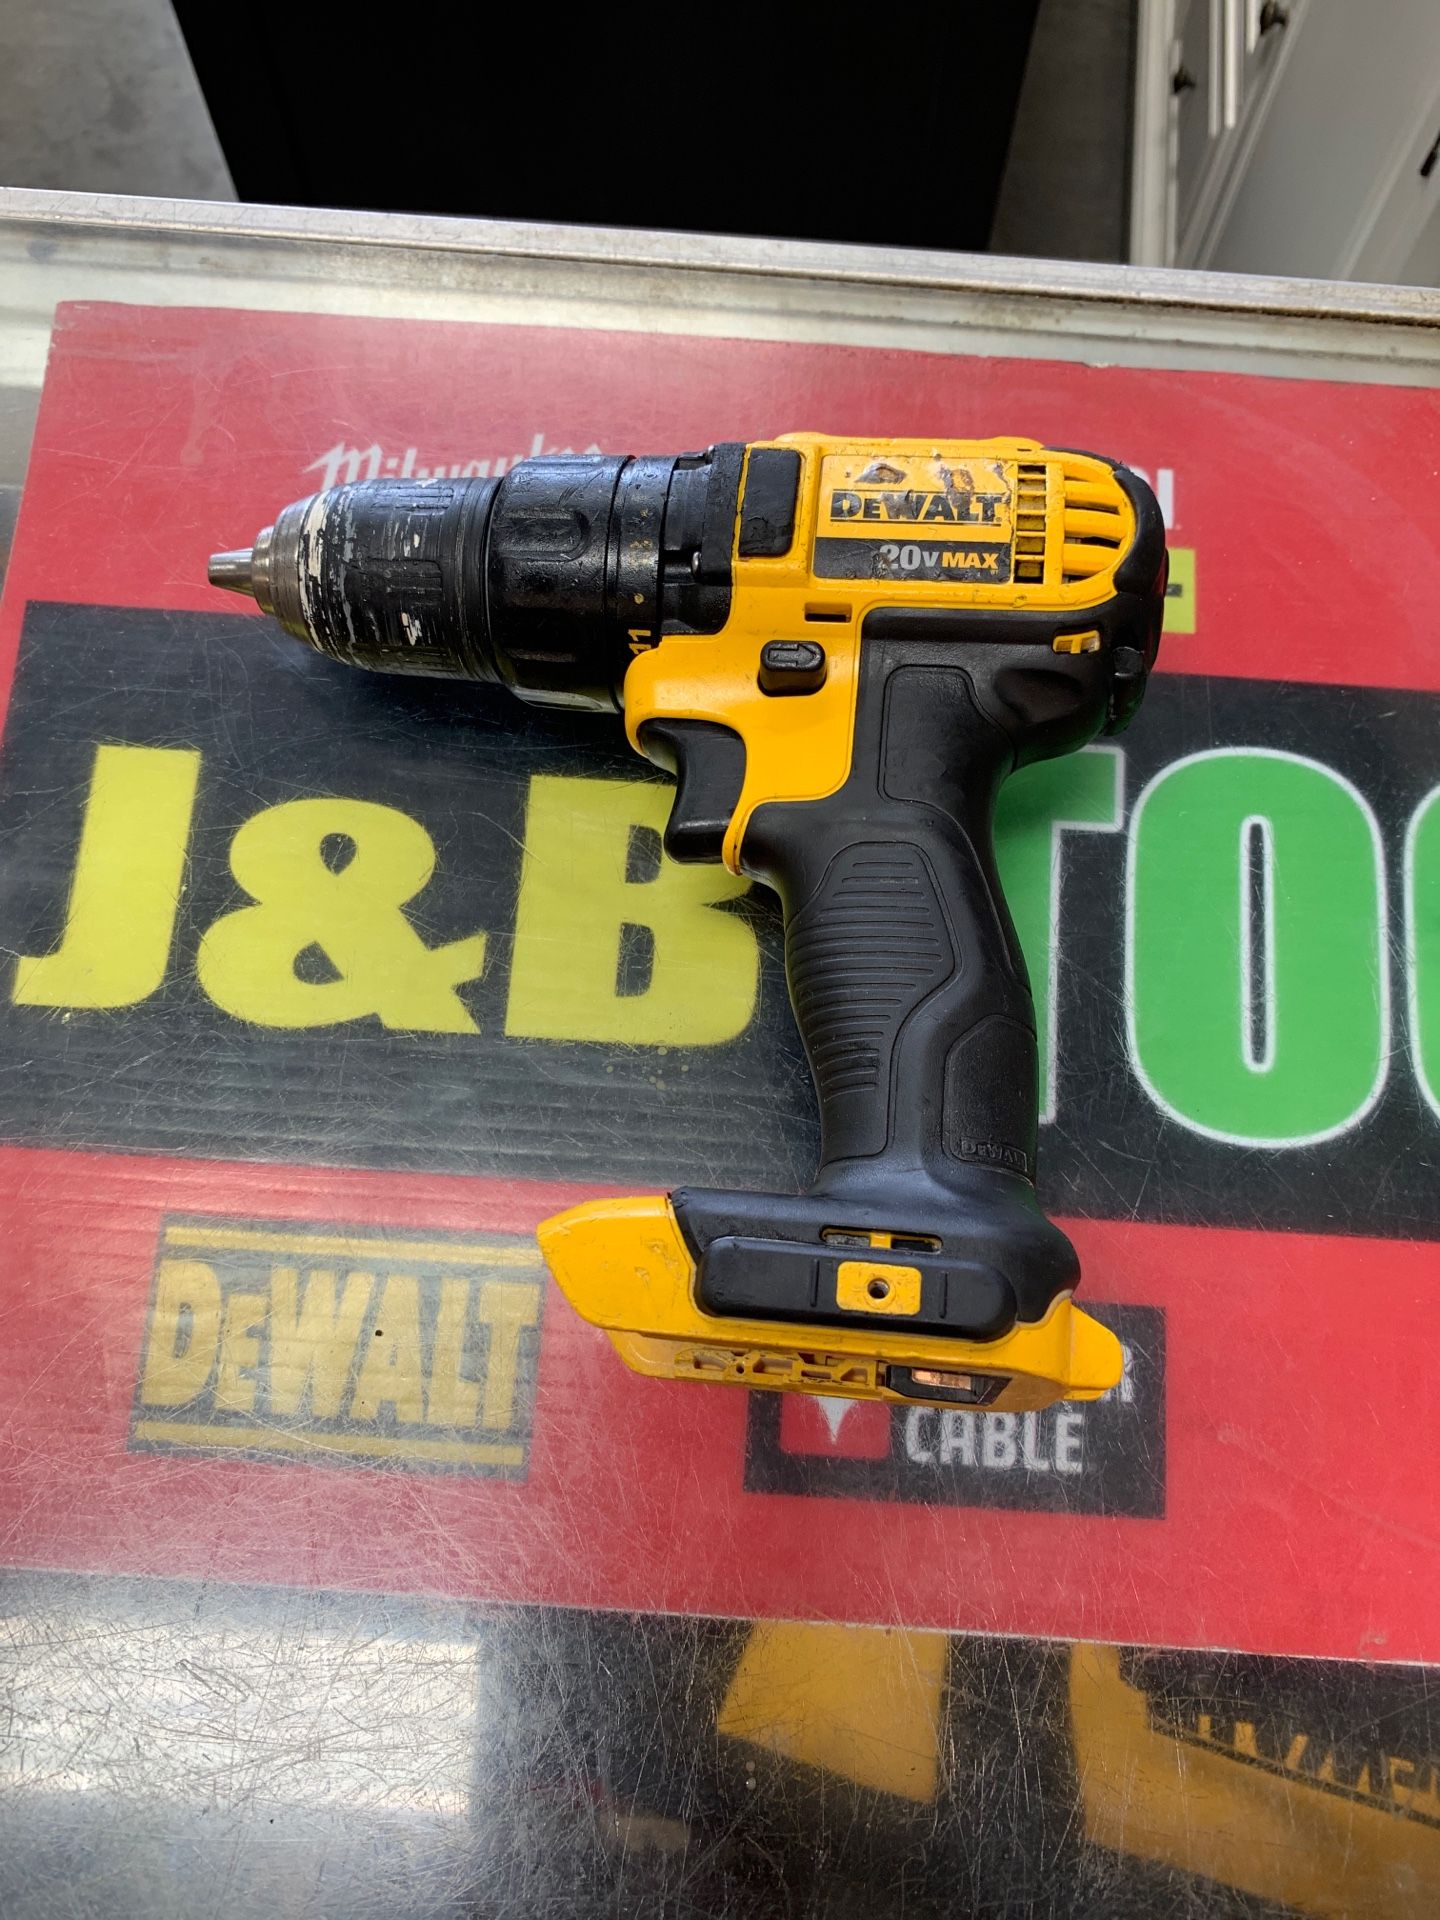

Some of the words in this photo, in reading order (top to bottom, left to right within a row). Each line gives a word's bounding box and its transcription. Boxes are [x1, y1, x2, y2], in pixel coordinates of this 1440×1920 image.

[831, 492, 1002, 522] DEWALT
[942, 551, 998, 570] MAX
[628, 628, 652, 655] 11
[12, 745, 759, 1046] J&B
[141, 1259, 540, 1429] DEWALT
[906, 1409, 1085, 1474] CABLE
